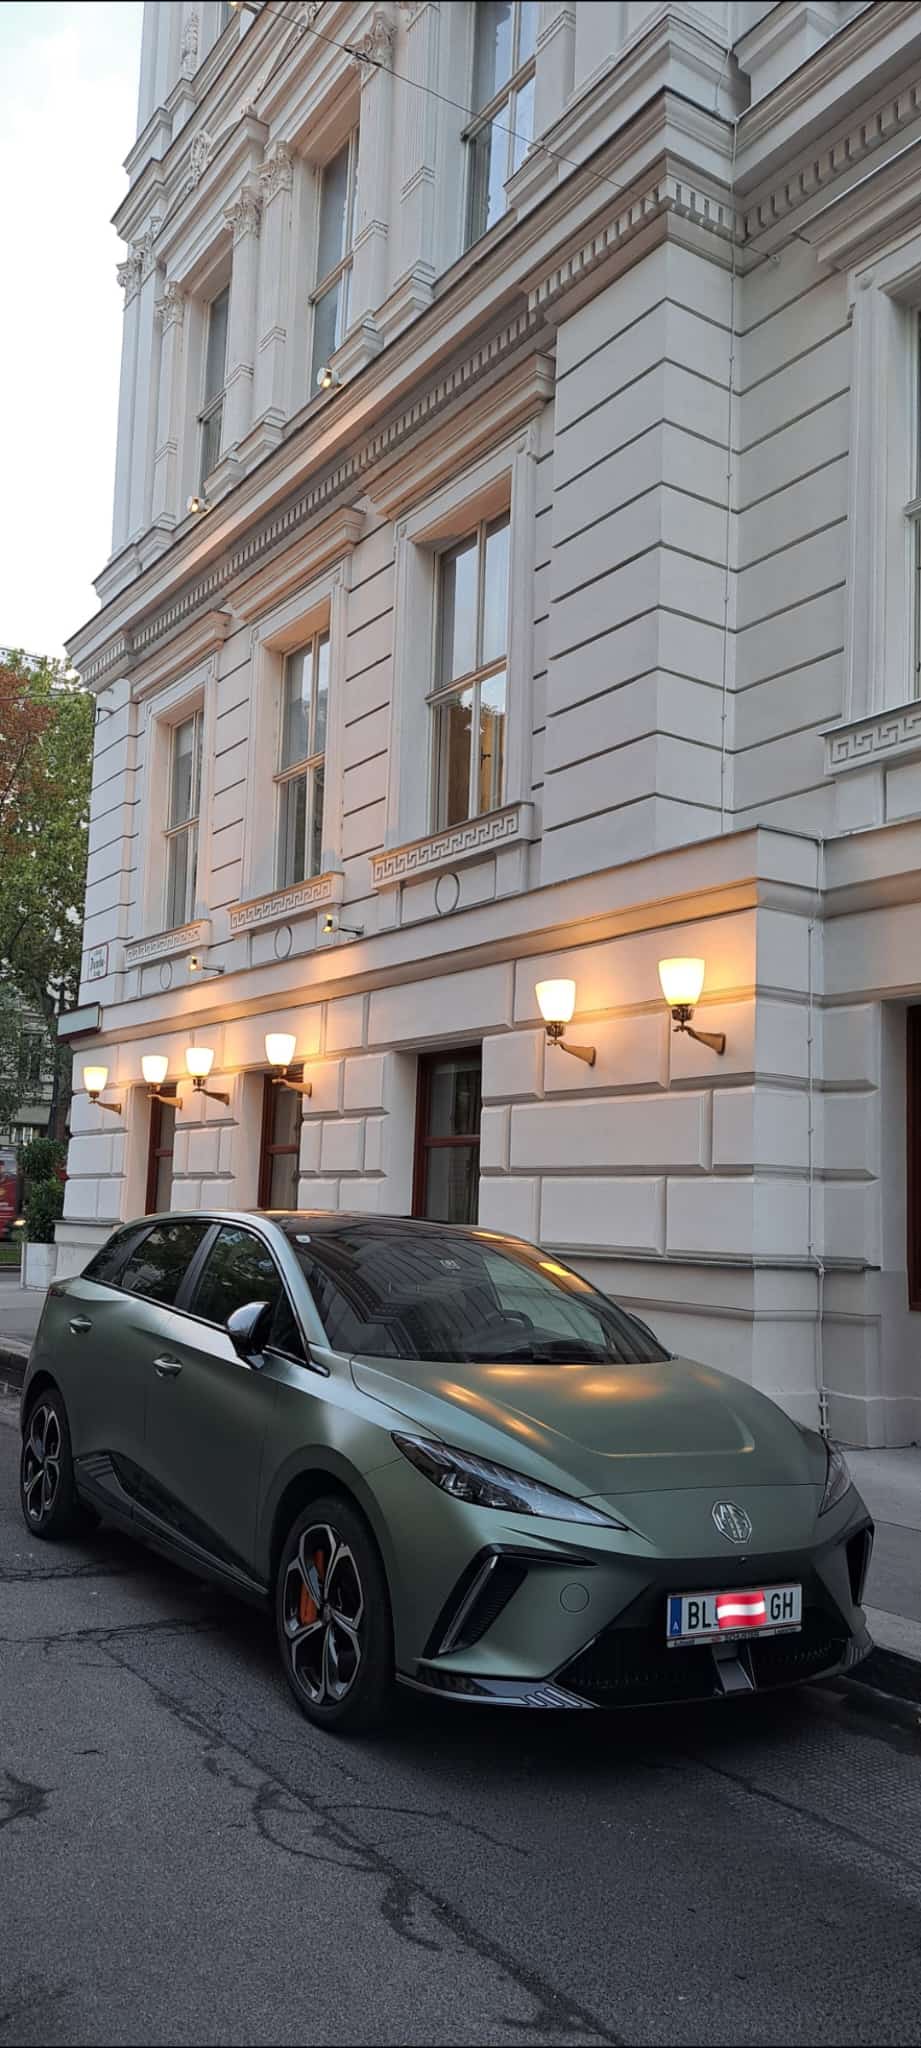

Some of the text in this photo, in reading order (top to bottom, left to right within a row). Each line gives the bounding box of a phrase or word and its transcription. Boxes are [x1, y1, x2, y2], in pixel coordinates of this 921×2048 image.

[715, 1502, 749, 1540] MG
[672, 1621, 680, 1632] A
[688, 1592, 793, 1629] BL GH
